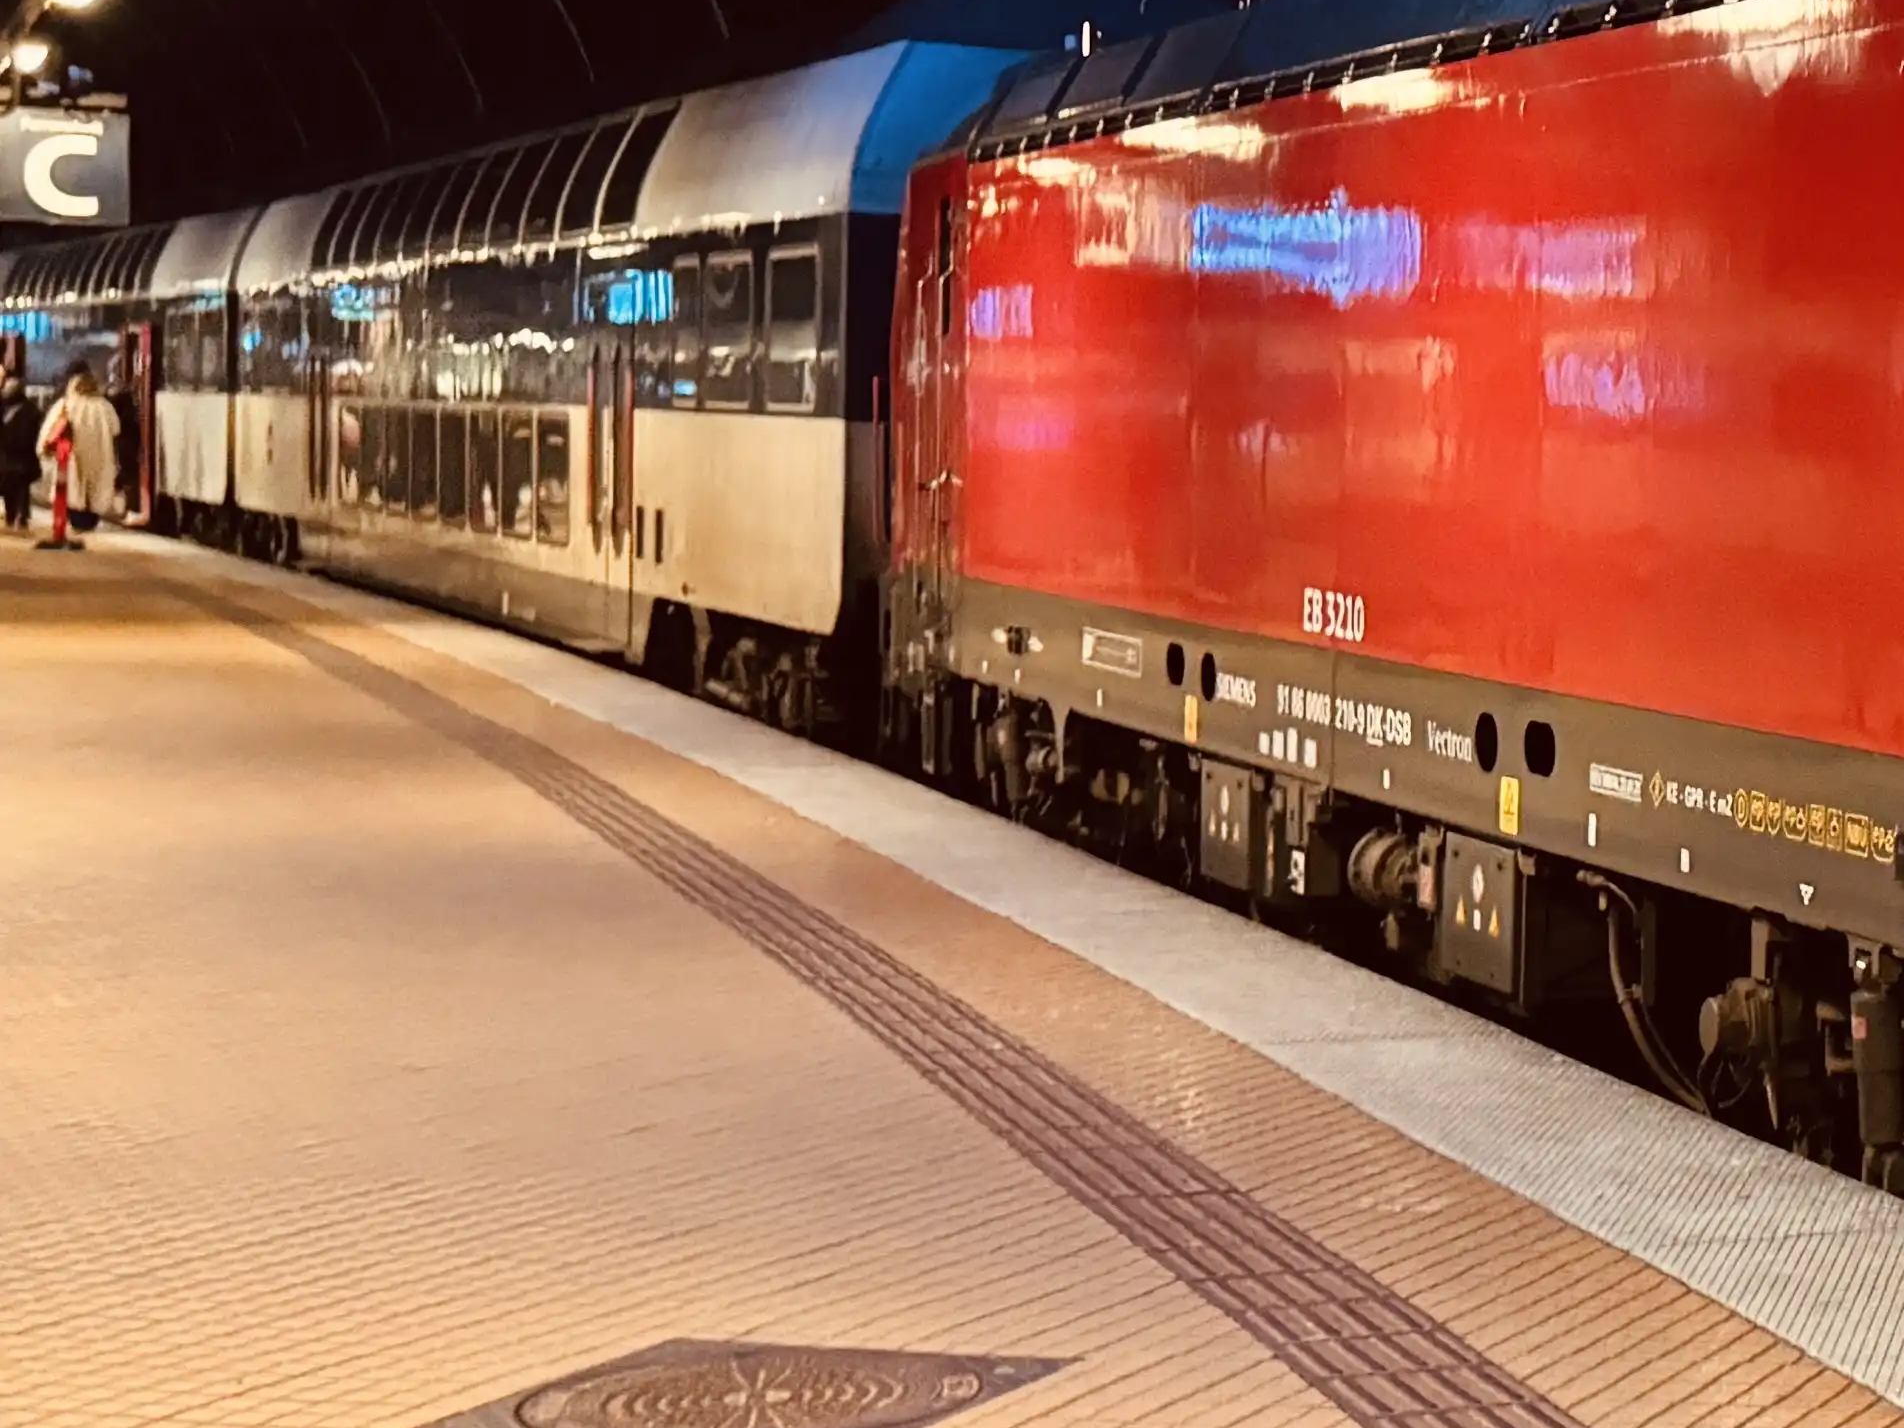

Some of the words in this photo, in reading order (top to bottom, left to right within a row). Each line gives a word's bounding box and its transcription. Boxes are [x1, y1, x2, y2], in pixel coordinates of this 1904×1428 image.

[23, 133, 100, 217] C
[1303, 586, 1323, 633] EB
[1324, 590, 1365, 643] 3210
[1217, 672, 1257, 708] SIEMENS
[1427, 720, 1473, 763] Vectron
